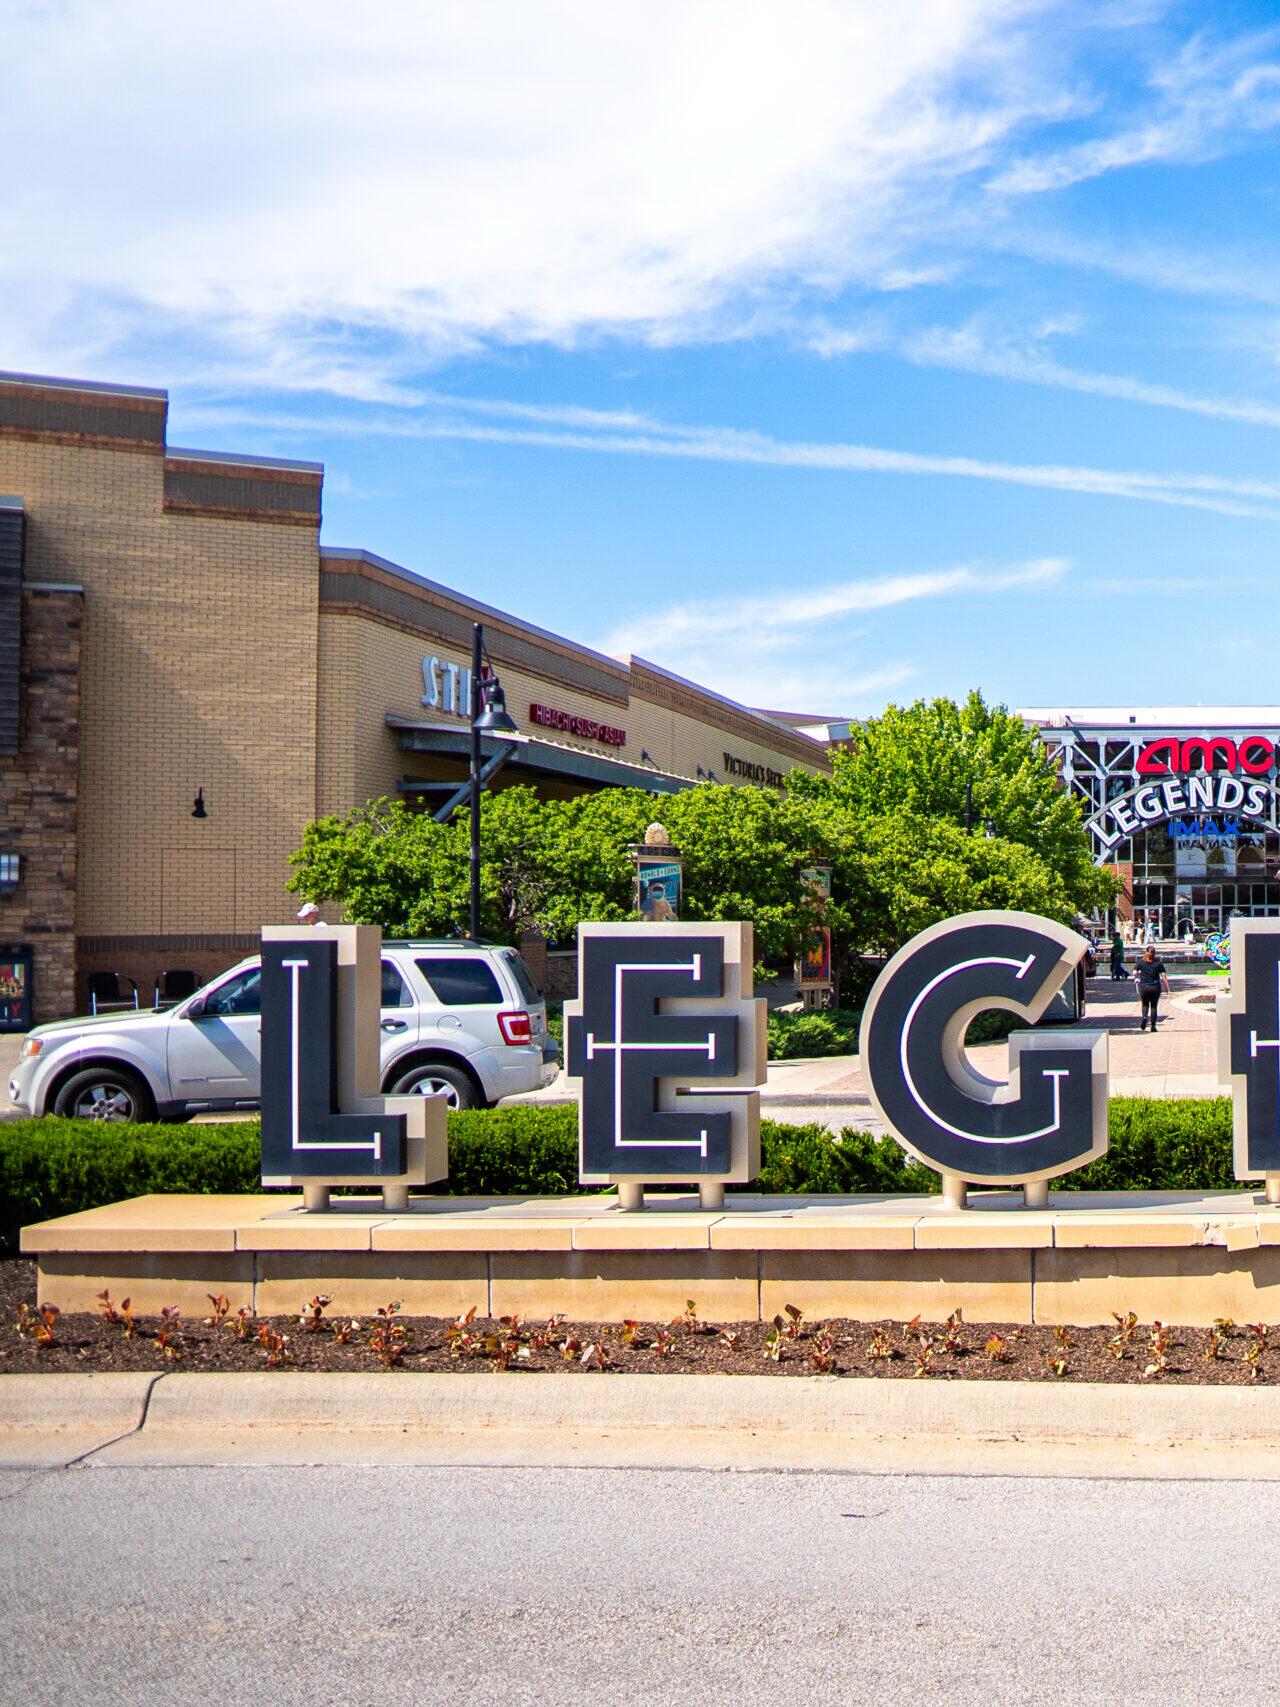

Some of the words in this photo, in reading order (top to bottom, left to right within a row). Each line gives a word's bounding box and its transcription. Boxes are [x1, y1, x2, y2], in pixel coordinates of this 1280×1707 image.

[536, 704, 571, 731] HIBACHI
[576, 718, 600, 740] SUSHI
[604, 727, 626, 746] ASIAN
[1088, 776, 1268, 848] LEGENDS
[1168, 820, 1241, 838] IMAX
